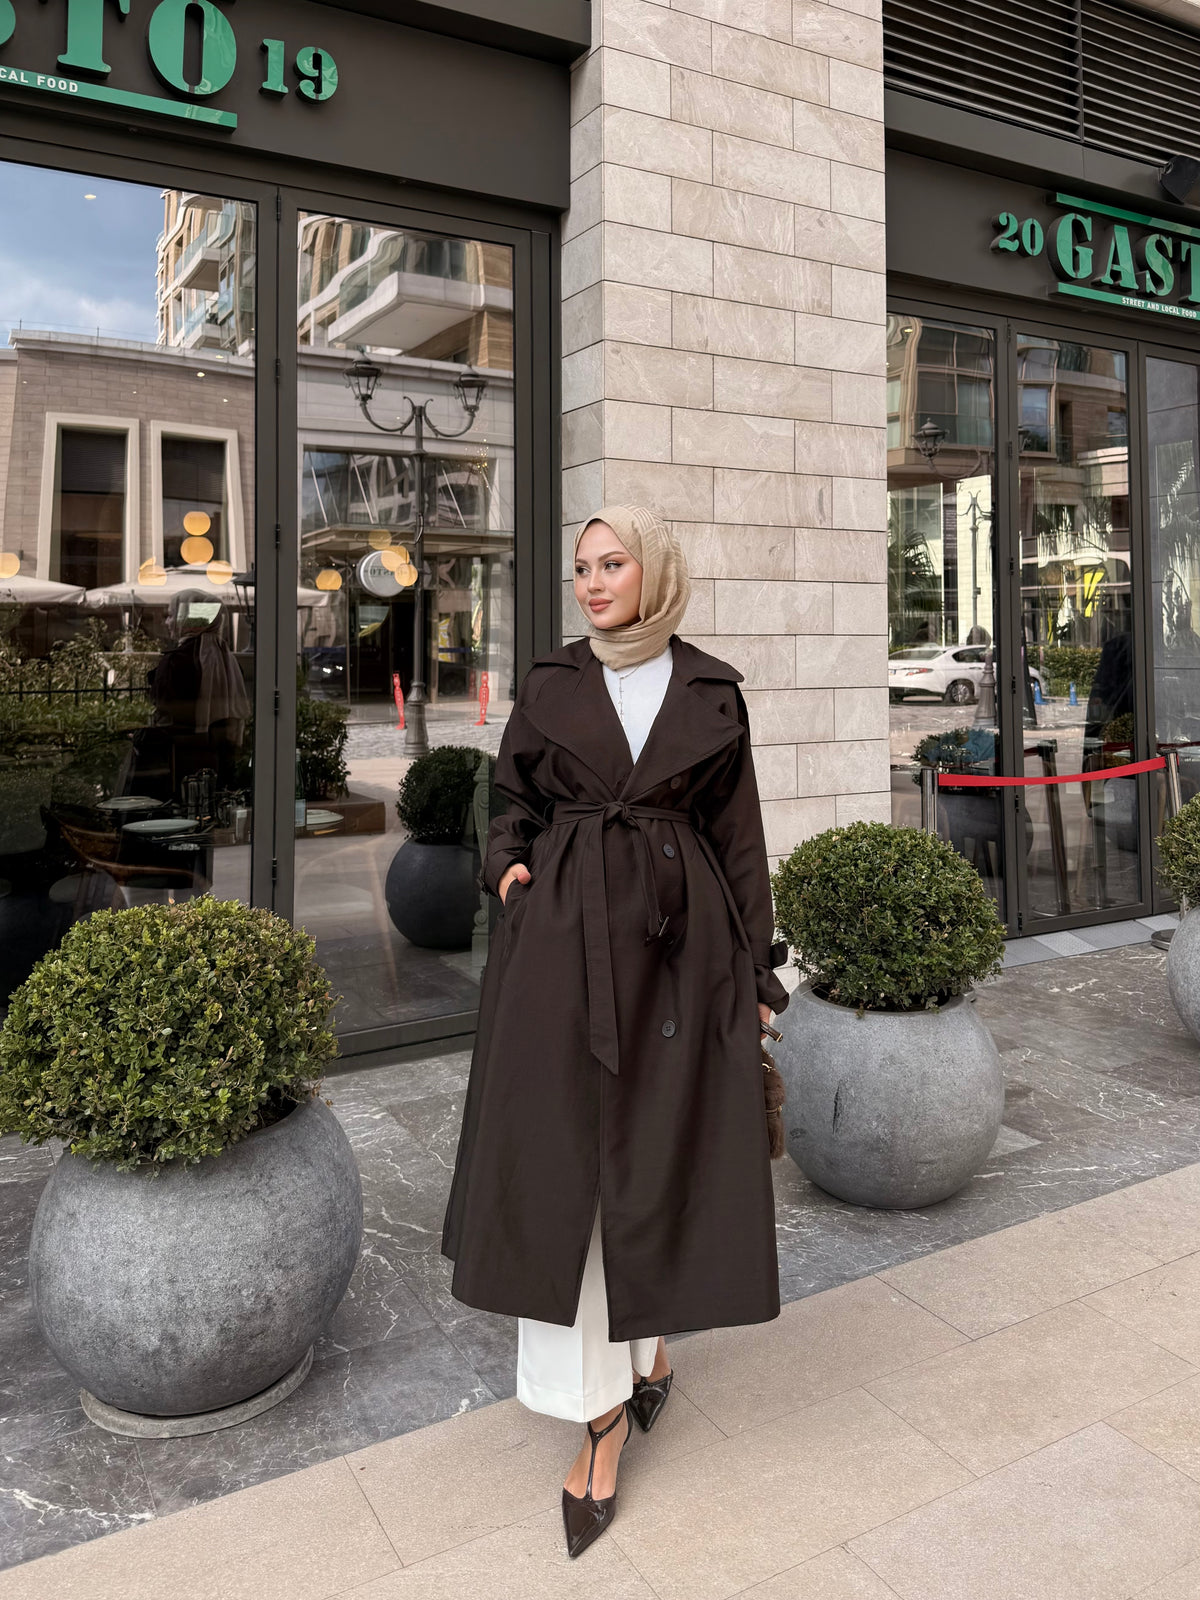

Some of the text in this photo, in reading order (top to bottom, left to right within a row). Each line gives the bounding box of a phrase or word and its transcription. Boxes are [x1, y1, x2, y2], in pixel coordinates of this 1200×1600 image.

[0, 0, 339, 101] TO 19
[37, 75, 78, 93] FOOD
[998, 211, 1044, 257] 20
[1122, 297, 1197, 318] STREET AND LOCAL FOOD
